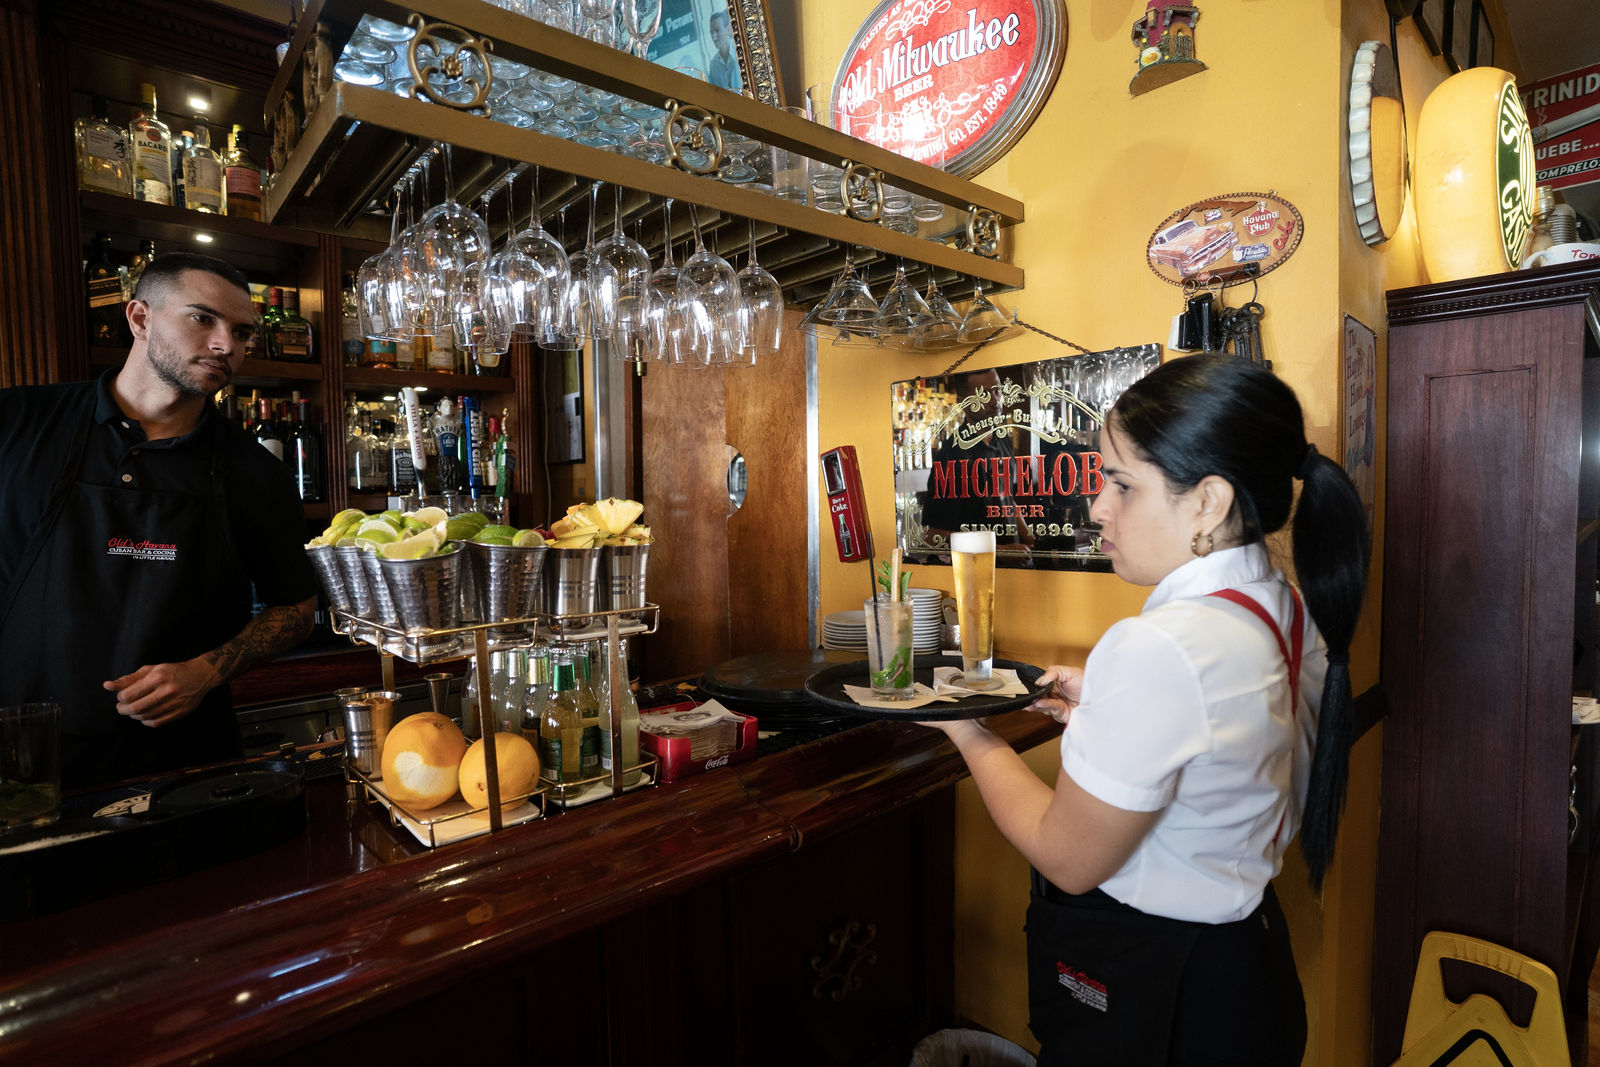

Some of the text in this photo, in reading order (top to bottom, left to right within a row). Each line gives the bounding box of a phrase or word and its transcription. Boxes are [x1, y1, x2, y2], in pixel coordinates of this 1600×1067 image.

[859, 2, 902, 51] TASTES AS
[876, 8, 1020, 94] Milwaukee
[893, 74, 934, 102] BEER
[963, 109, 988, 135] EST.
[982, 83, 1008, 115] 1849
[1242, 211, 1279, 225] Havana
[1250, 221, 1271, 235] Club
[409, 403, 423, 460] STELLA ARTOIS
[1056, 416, 1077, 439] Inc.
[469, 409, 480, 476] BUD LIGHT
[933, 451, 1105, 499] MICHELOB
[986, 504, 1045, 518] BEER
[960, 523, 1075, 537] SINCE 1896
[136, 540, 177, 550] Havana
